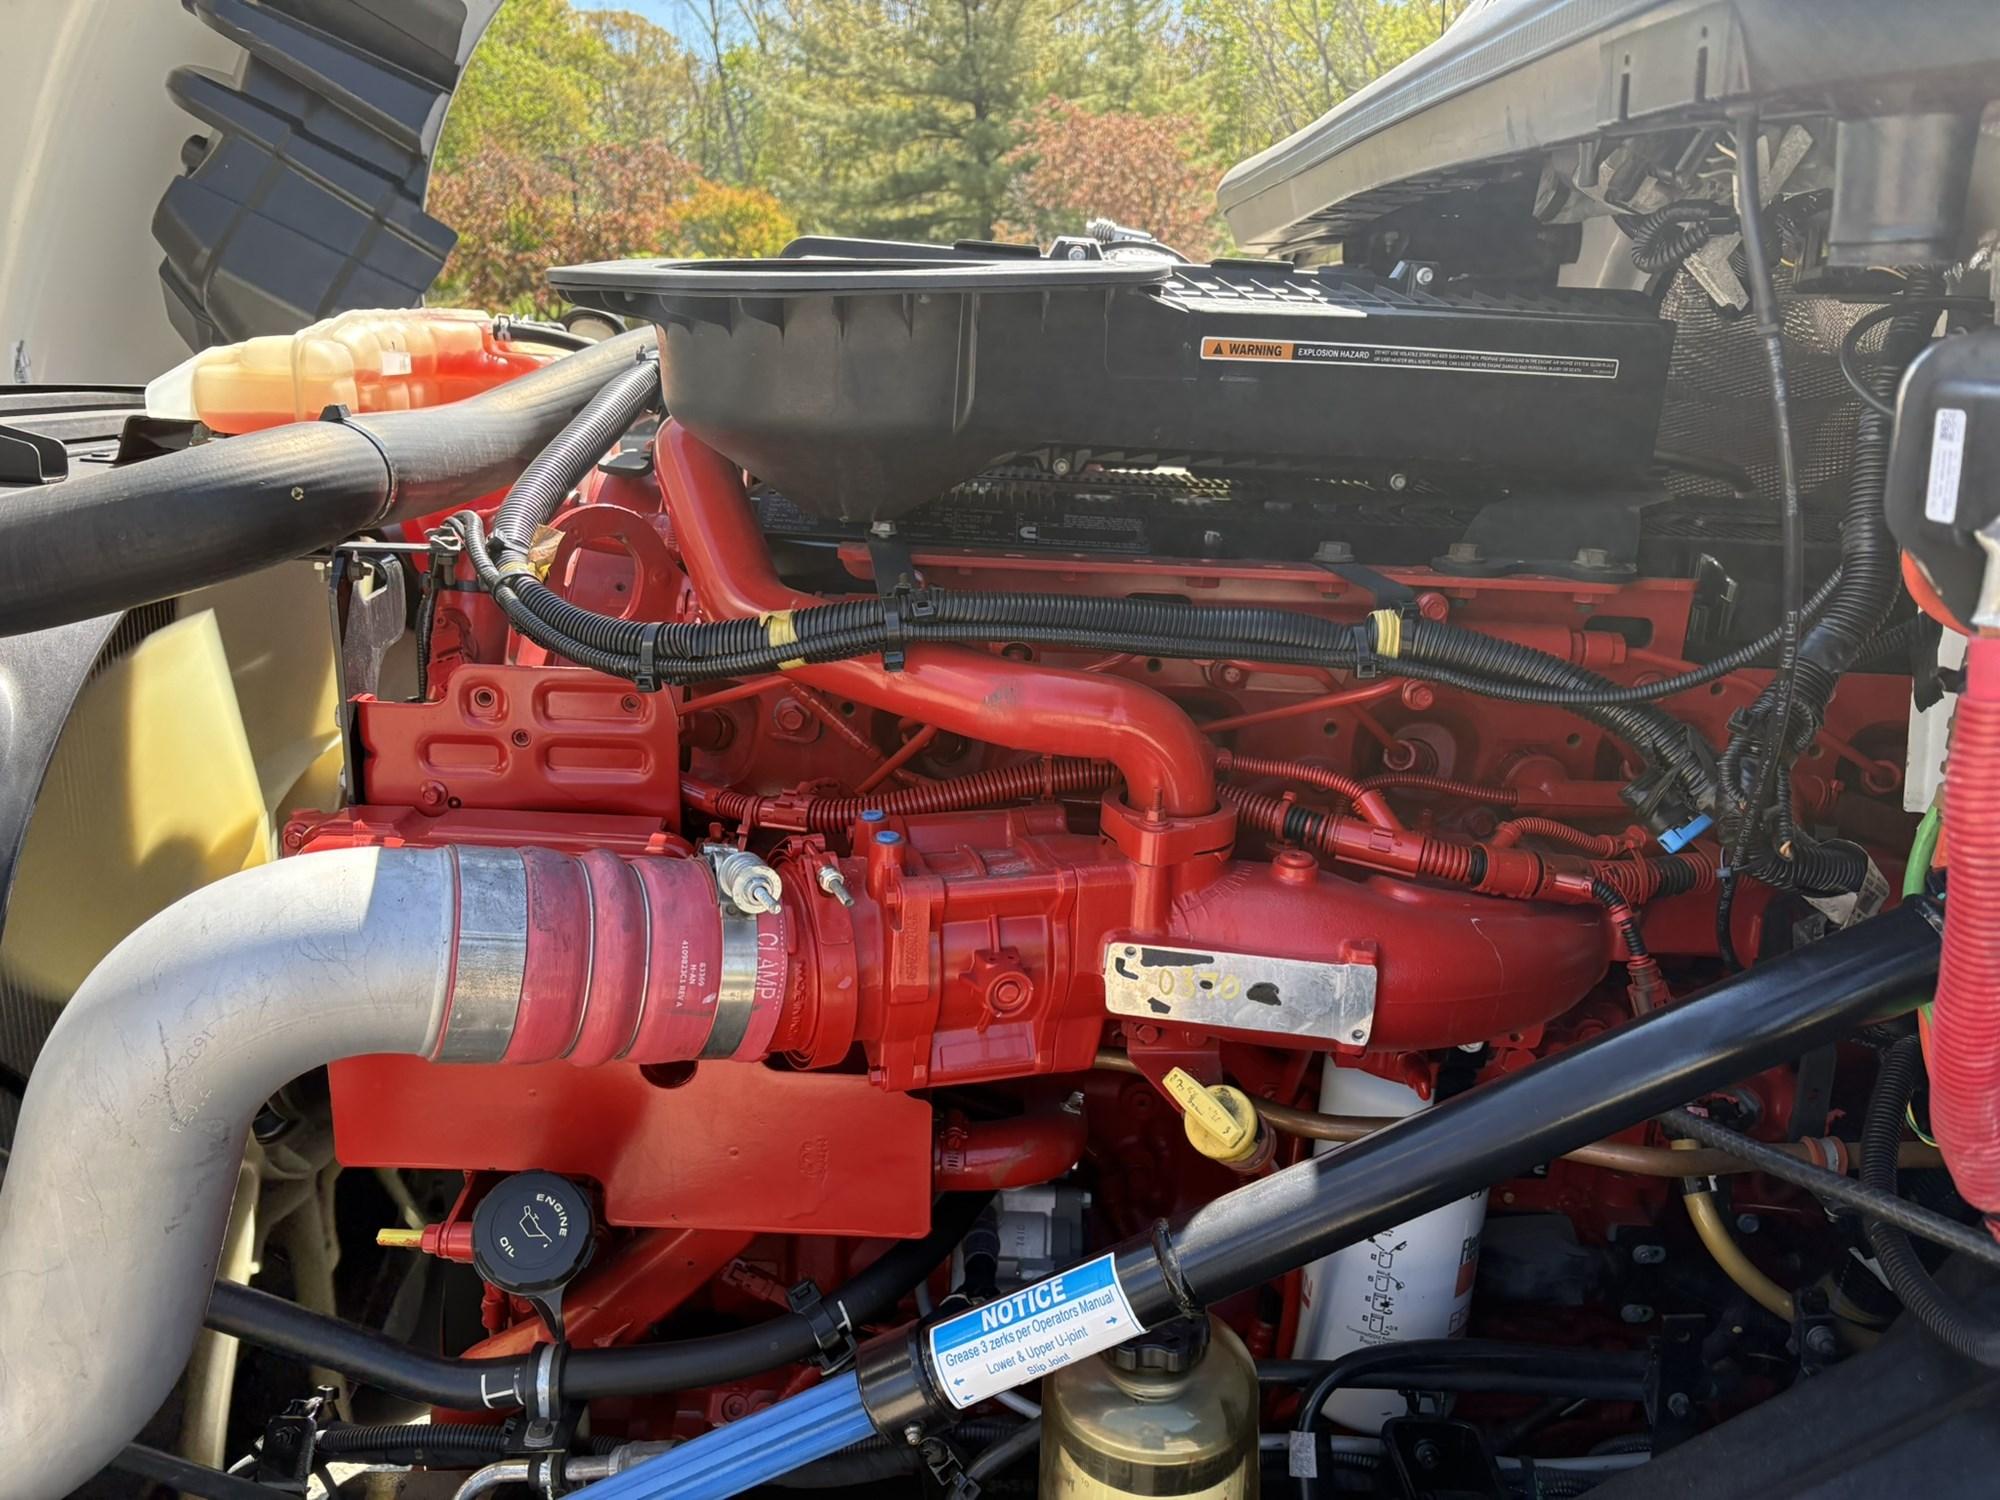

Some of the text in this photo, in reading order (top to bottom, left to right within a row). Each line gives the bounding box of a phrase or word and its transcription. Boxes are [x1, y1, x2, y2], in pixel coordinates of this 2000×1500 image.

[1229, 343, 1282, 357] WARNING
[1297, 347, 1338, 358] EXPLOSION
[1339, 349, 1370, 359] HAZARD
[536, 1193, 568, 1237] ENGINE
[499, 1236, 515, 1258] OIL
[981, 1278, 1067, 1332] NOTICE
[946, 1290, 1115, 1367] Grease 3 zerks per Operators Manual
[987, 1326, 1088, 1375] Lower & Upper U-joint
[1027, 1352, 1070, 1375] Slip Joint
